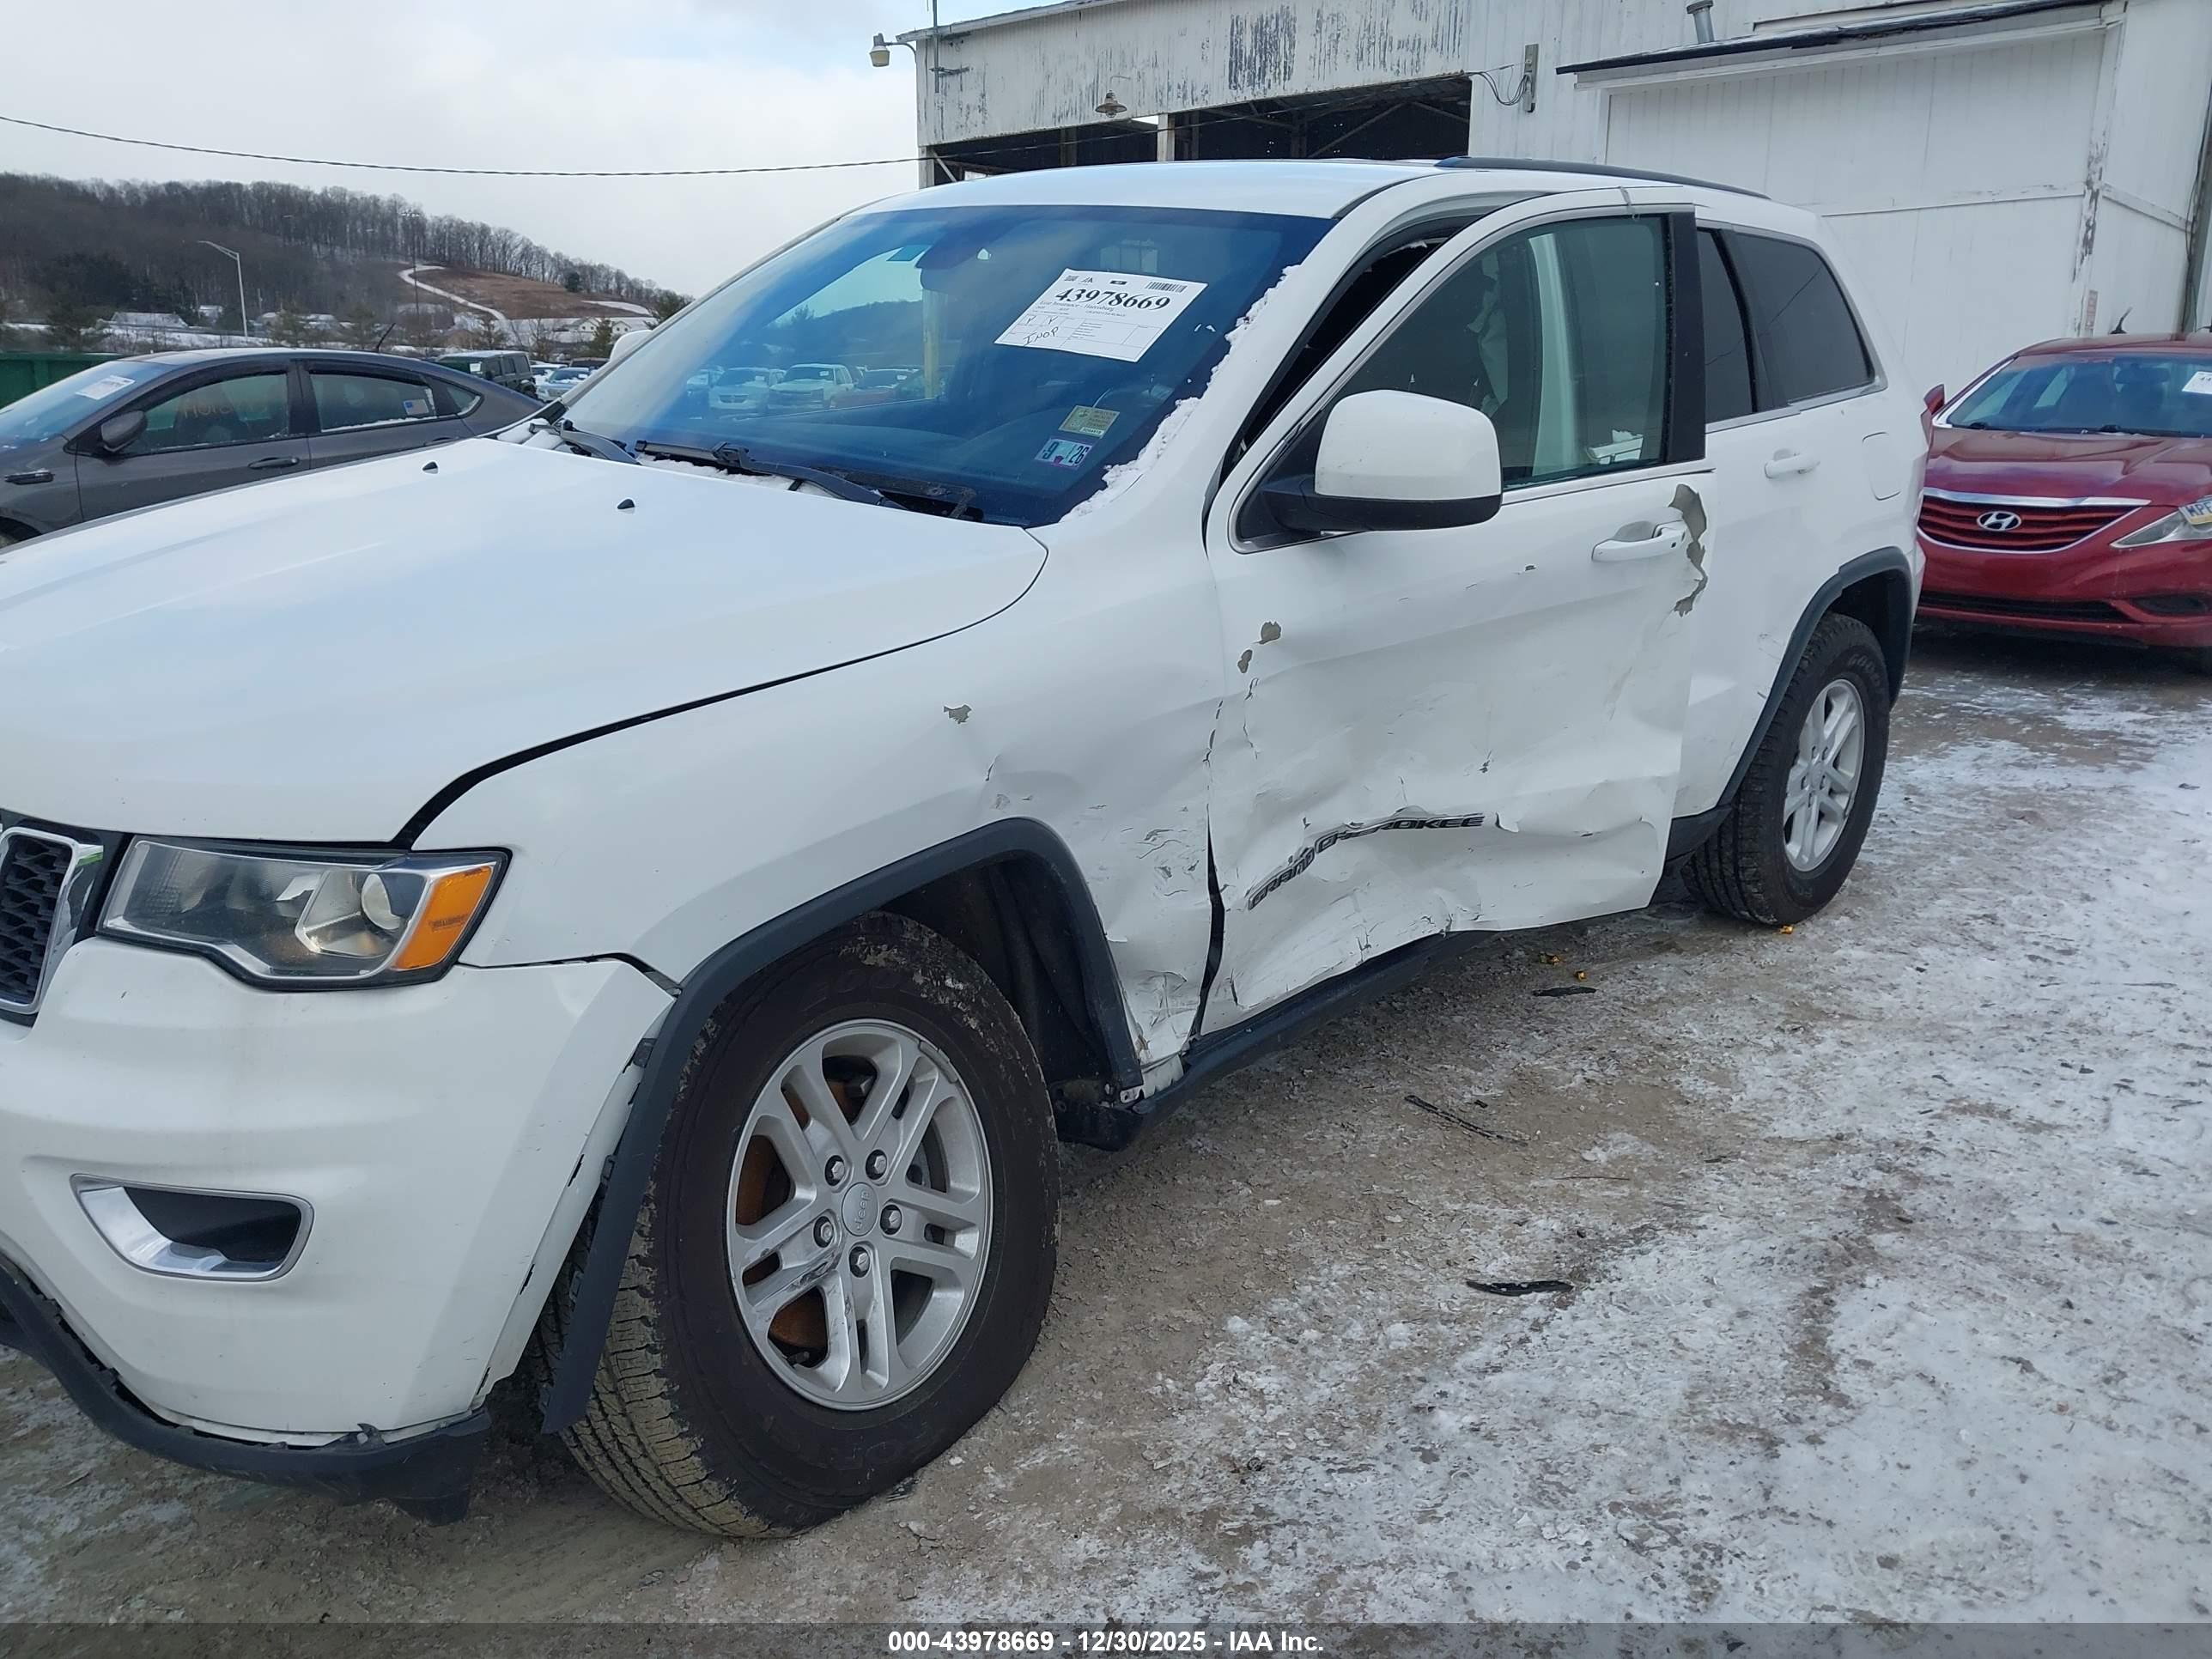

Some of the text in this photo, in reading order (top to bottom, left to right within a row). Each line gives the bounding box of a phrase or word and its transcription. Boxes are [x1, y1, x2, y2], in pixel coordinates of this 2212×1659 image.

[1055, 289, 1171, 310] 43978669
[1068, 445, 1090, 465] 26
[854, 1188, 872, 1231] Jeep
